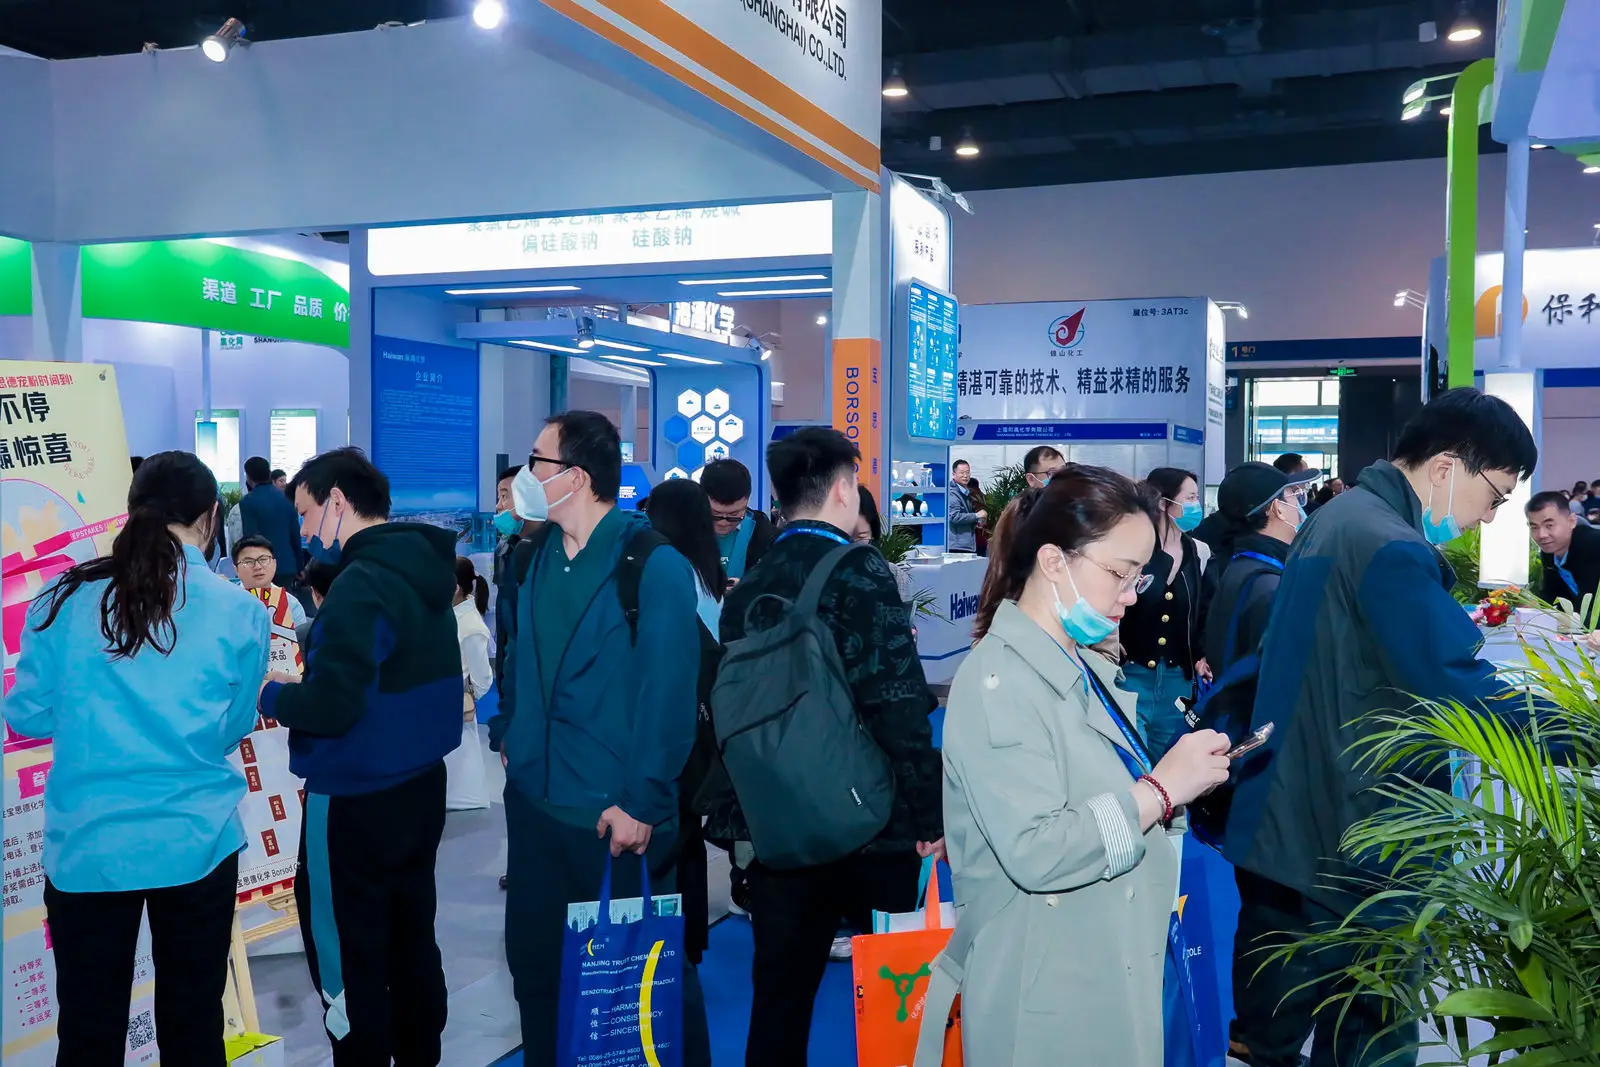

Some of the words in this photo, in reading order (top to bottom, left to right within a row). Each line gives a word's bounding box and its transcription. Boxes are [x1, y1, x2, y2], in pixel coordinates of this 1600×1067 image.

[808, 33, 847, 81] CO.,LTD.
[521, 230, 599, 254] 偏硅酸钠
[632, 226, 693, 248] 硅酸钠
[202, 277, 238, 305] 渠道
[250, 287, 282, 310] 工厂
[293, 294, 323, 319] 品质
[333, 301, 350, 323] 价
[957, 366, 1191, 396] 精湛可靠的技术、精益求精的服务
[0, 391, 50, 424] 不停
[950, 591, 979, 621] Haiwa
[268, 649, 287, 662] 奖品
[271, 865, 294, 879] Borsod
[582, 959, 611, 969] NANJING
